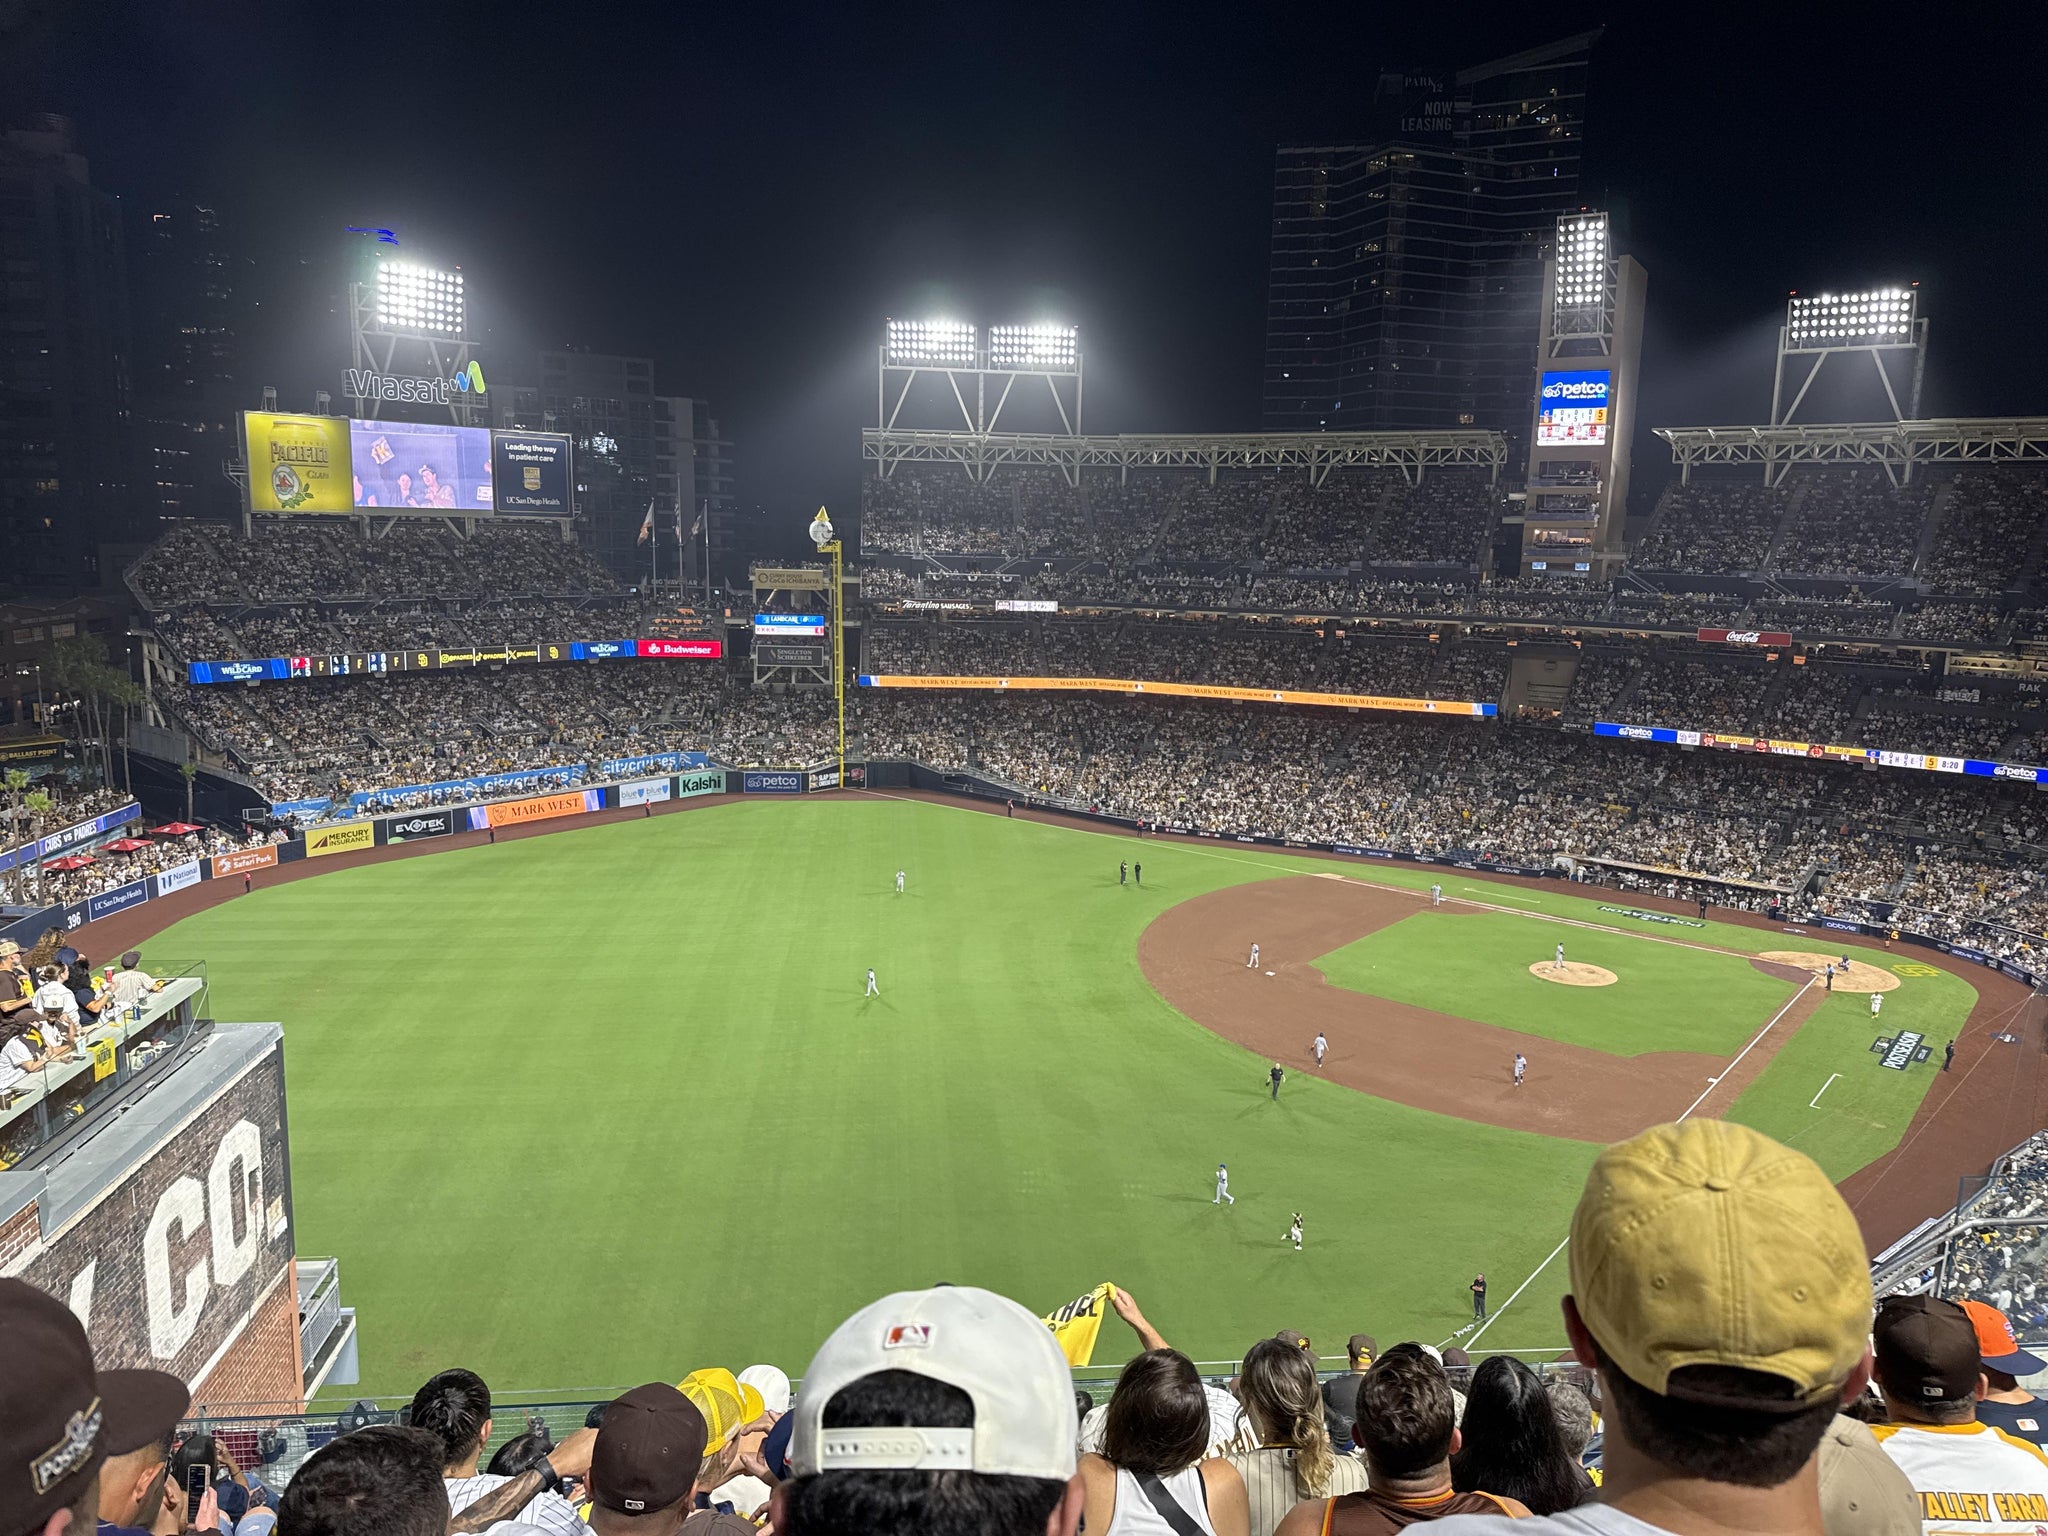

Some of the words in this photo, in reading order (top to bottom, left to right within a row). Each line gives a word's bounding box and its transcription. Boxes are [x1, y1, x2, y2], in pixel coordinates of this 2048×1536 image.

[1424, 101, 1453, 116] NOW
[1401, 117, 1452, 132] LEASING
[349, 368, 449, 404] Viasat
[1562, 381, 1606, 398] petco
[505, 442, 532, 452] Leading
[532, 444, 543, 452] the
[508, 452, 515, 460] in
[516, 453, 538, 461] patient
[527, 497, 542, 506] Diego
[902, 600, 939, 609] Tarantino
[664, 644, 712, 654] Budweiser
[304, 658, 310, 667] 3
[318, 662, 324, 671] F
[357, 659, 362, 669] F
[394, 657, 399, 666] F
[344, 665, 350, 674] 3
[381, 662, 387, 672] 9
[2018, 684, 2040, 692] RAK
[1629, 728, 1653, 737] petco
[9, 750, 37, 758] BALLAST
[1942, 761, 1959, 769] 8:20
[2006, 768, 2037, 778] petco
[682, 775, 721, 793] Kalshi
[763, 776, 797, 788] petco
[511, 804, 544, 817] MARK
[548, 798, 580, 811] WEST
[45, 834, 62, 852] CUBS
[74, 822, 96, 841] PADRES
[329, 829, 369, 840] MERCURY
[329, 835, 370, 847] INSURANCE
[233, 859, 255, 869] Safari
[256, 854, 272, 864] Park
[173, 867, 197, 880] National
[94, 901, 103, 910] UC
[104, 900, 113, 908] San
[113, 895, 127, 904] Diego
[127, 888, 142, 899] Health
[67, 911, 81, 930] 396
[1826, 921, 1857, 932] abbvie
[1882, 1031, 1922, 1070] POSTSEASON
